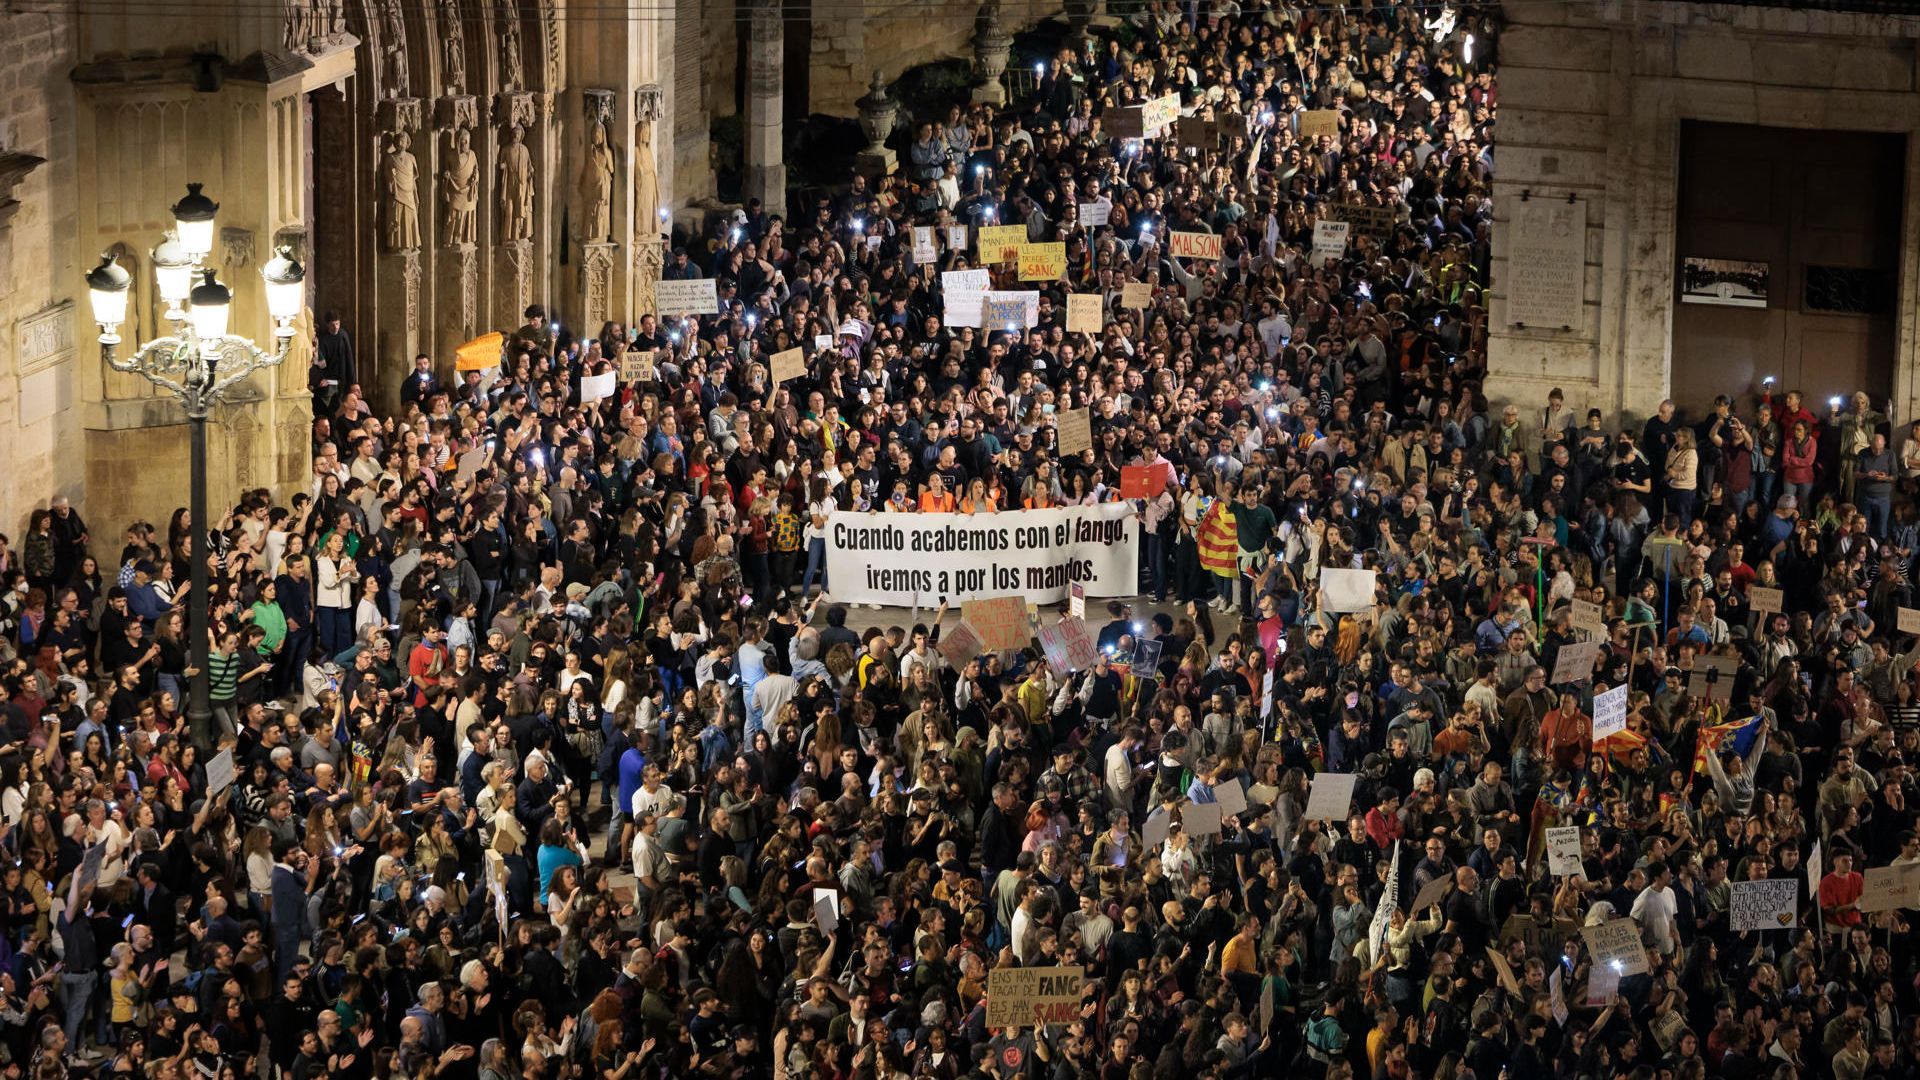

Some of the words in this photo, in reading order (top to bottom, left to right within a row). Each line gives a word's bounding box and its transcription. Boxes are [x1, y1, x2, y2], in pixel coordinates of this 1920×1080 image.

[999, 246, 1018, 259] FAN
[1173, 234, 1220, 258] MALSON
[1027, 264, 1057, 277] SANG
[834, 522, 905, 551] Cuando
[910, 524, 1010, 552] acabemos
[1015, 525, 1050, 549] con
[1055, 518, 1071, 545] el
[1076, 518, 1129, 547] fango,
[866, 563, 931, 592] iremos
[938, 570, 949, 593] a
[955, 566, 987, 596] por
[992, 562, 1020, 590] los
[1027, 558, 1098, 590] mandos.
[989, 597, 1019, 609] MALA
[648, 803, 659, 813] 47
[992, 971, 1012, 984] ENS
[1016, 970, 1037, 983] HAN
[992, 984, 1018, 996] TACAT
[1023, 985, 1036, 996] DE
[1039, 975, 1081, 996] FANG
[991, 1001, 1008, 1013] ELS
[1013, 1000, 1031, 1013] HAN
[1033, 1002, 1081, 1022] SANG
